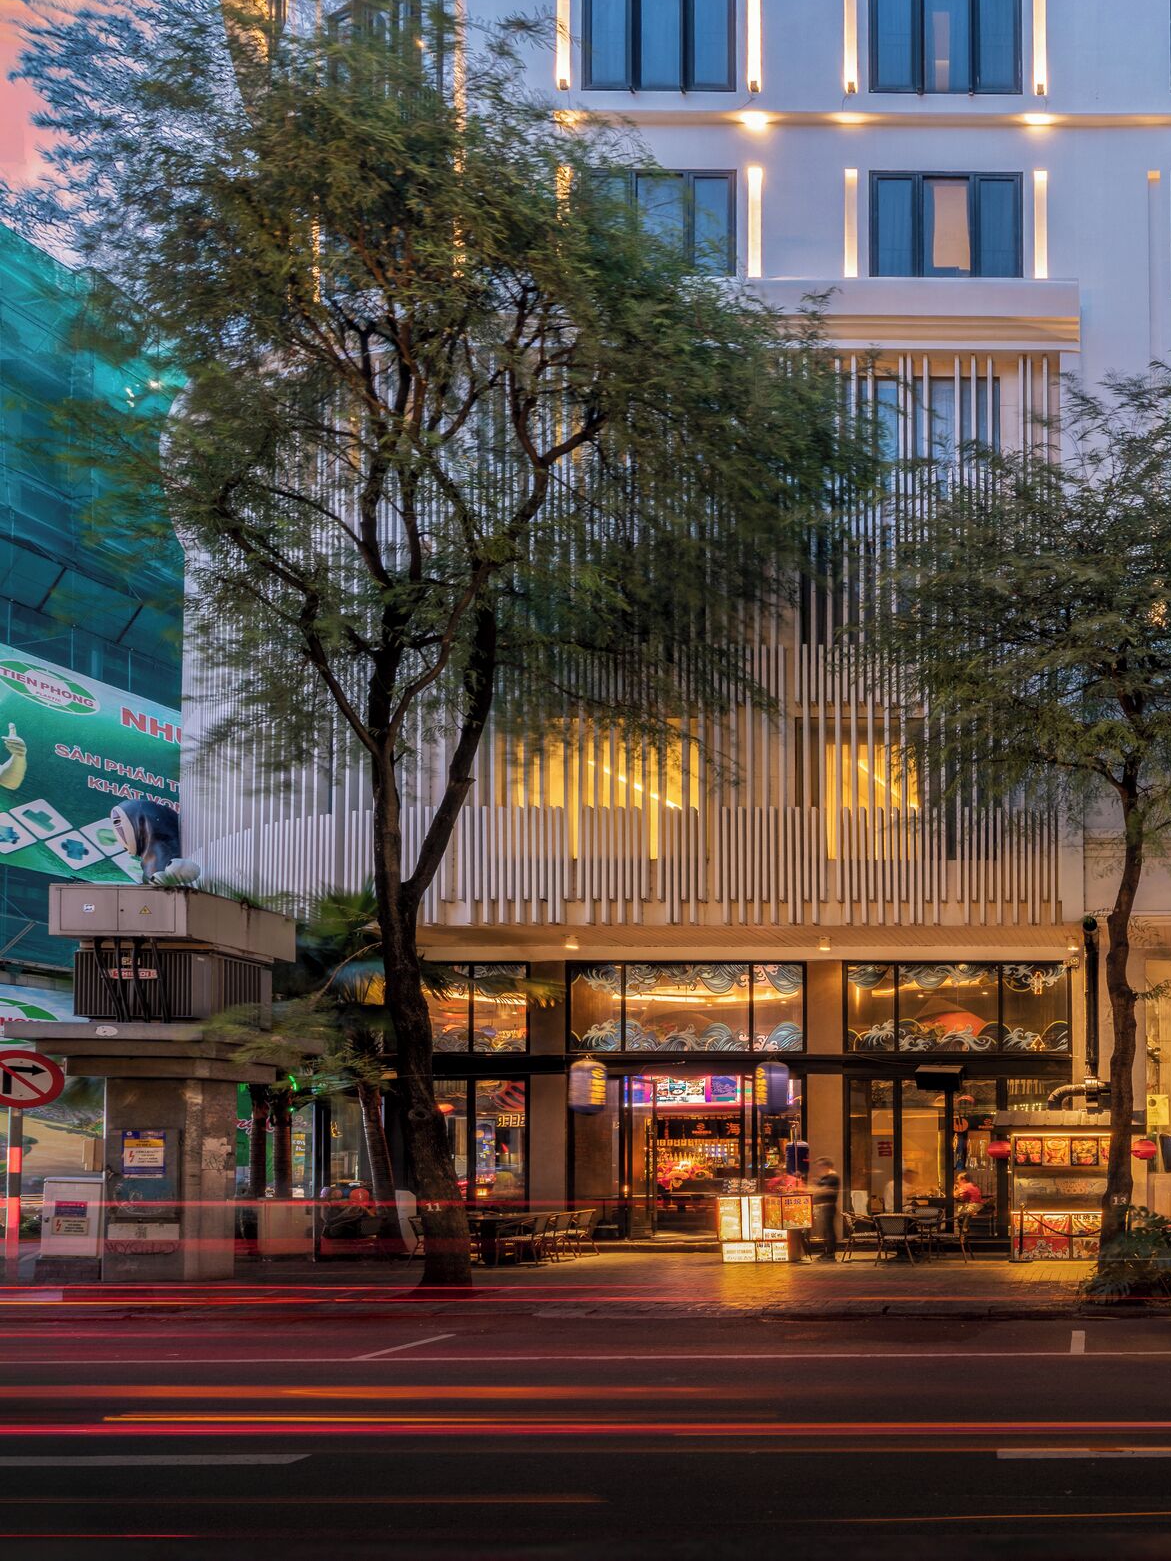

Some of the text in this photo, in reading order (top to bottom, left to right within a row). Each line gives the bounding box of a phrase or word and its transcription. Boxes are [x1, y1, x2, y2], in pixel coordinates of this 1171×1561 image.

[40, 681, 94, 707] PHONG
[1112, 1196, 1127, 1206] 13
[426, 1202, 442, 1212] 11
